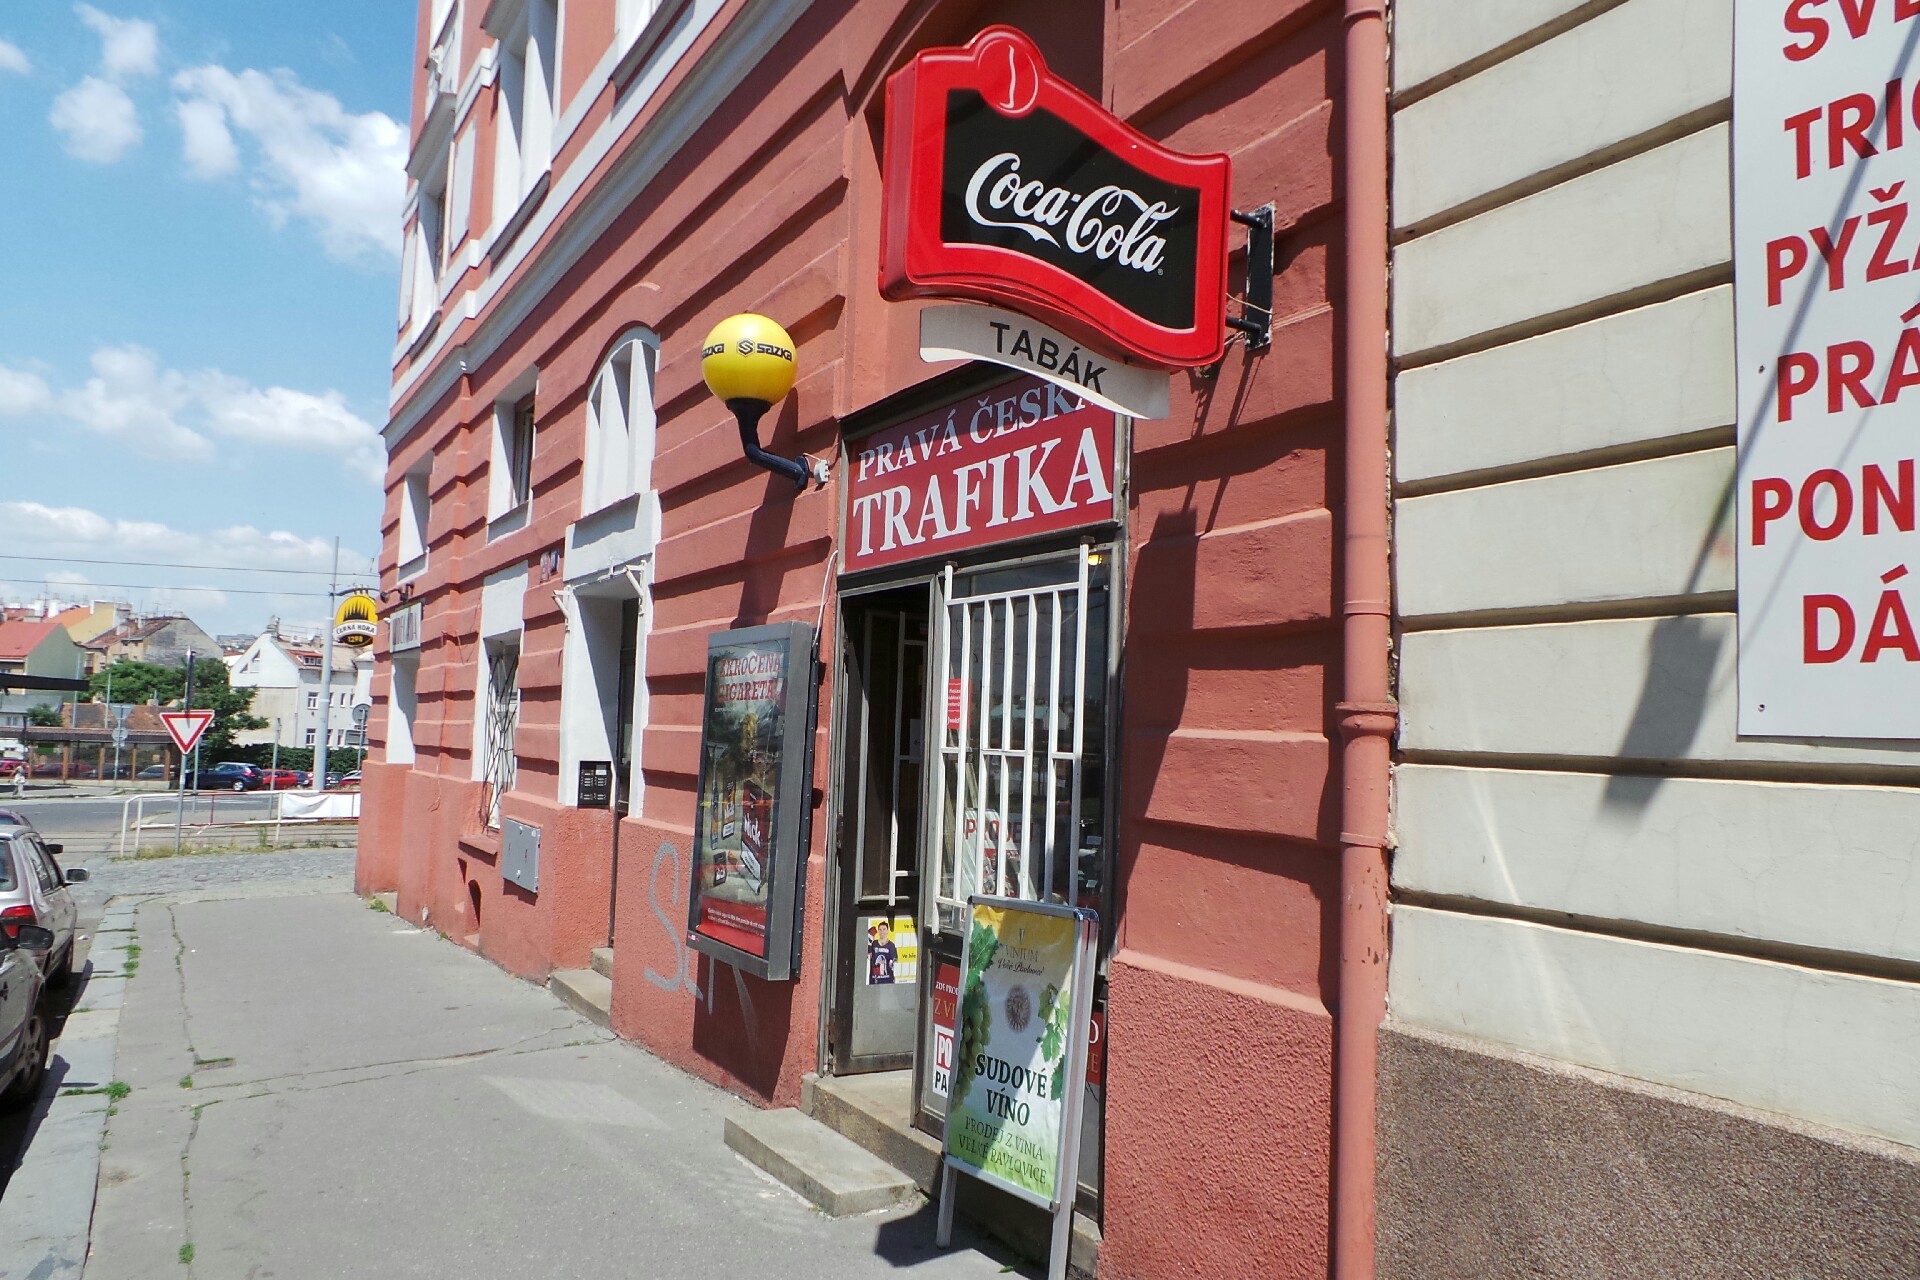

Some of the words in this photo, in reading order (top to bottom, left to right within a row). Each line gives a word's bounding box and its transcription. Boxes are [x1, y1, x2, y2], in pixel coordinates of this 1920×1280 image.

[1783, 0, 1920, 61] SV
[1784, 77, 1920, 179] TRI
[965, 152, 1180, 273] Coca-Cola
[1766, 180, 1920, 307] PYŽ
[989, 321, 1107, 395] TABÁK
[857, 409, 962, 482] PRAVÁ
[969, 382, 1093, 445] ČESK
[853, 427, 1112, 557] TRAFIKA
[1752, 459, 1915, 546] PON
[1803, 564, 1920, 664] DÁ
[935, 1071, 948, 1093] PA
[974, 1053, 1048, 1098] SUDOVÉ
[986, 1087, 1030, 1127] VÍNO
[959, 1134, 988, 1160] VELKÉ
[990, 1148, 1047, 1185] PAVLOVICE
[965, 1116, 1004, 1144] PRODEJ
[1004, 1132, 1014, 1148] Z
